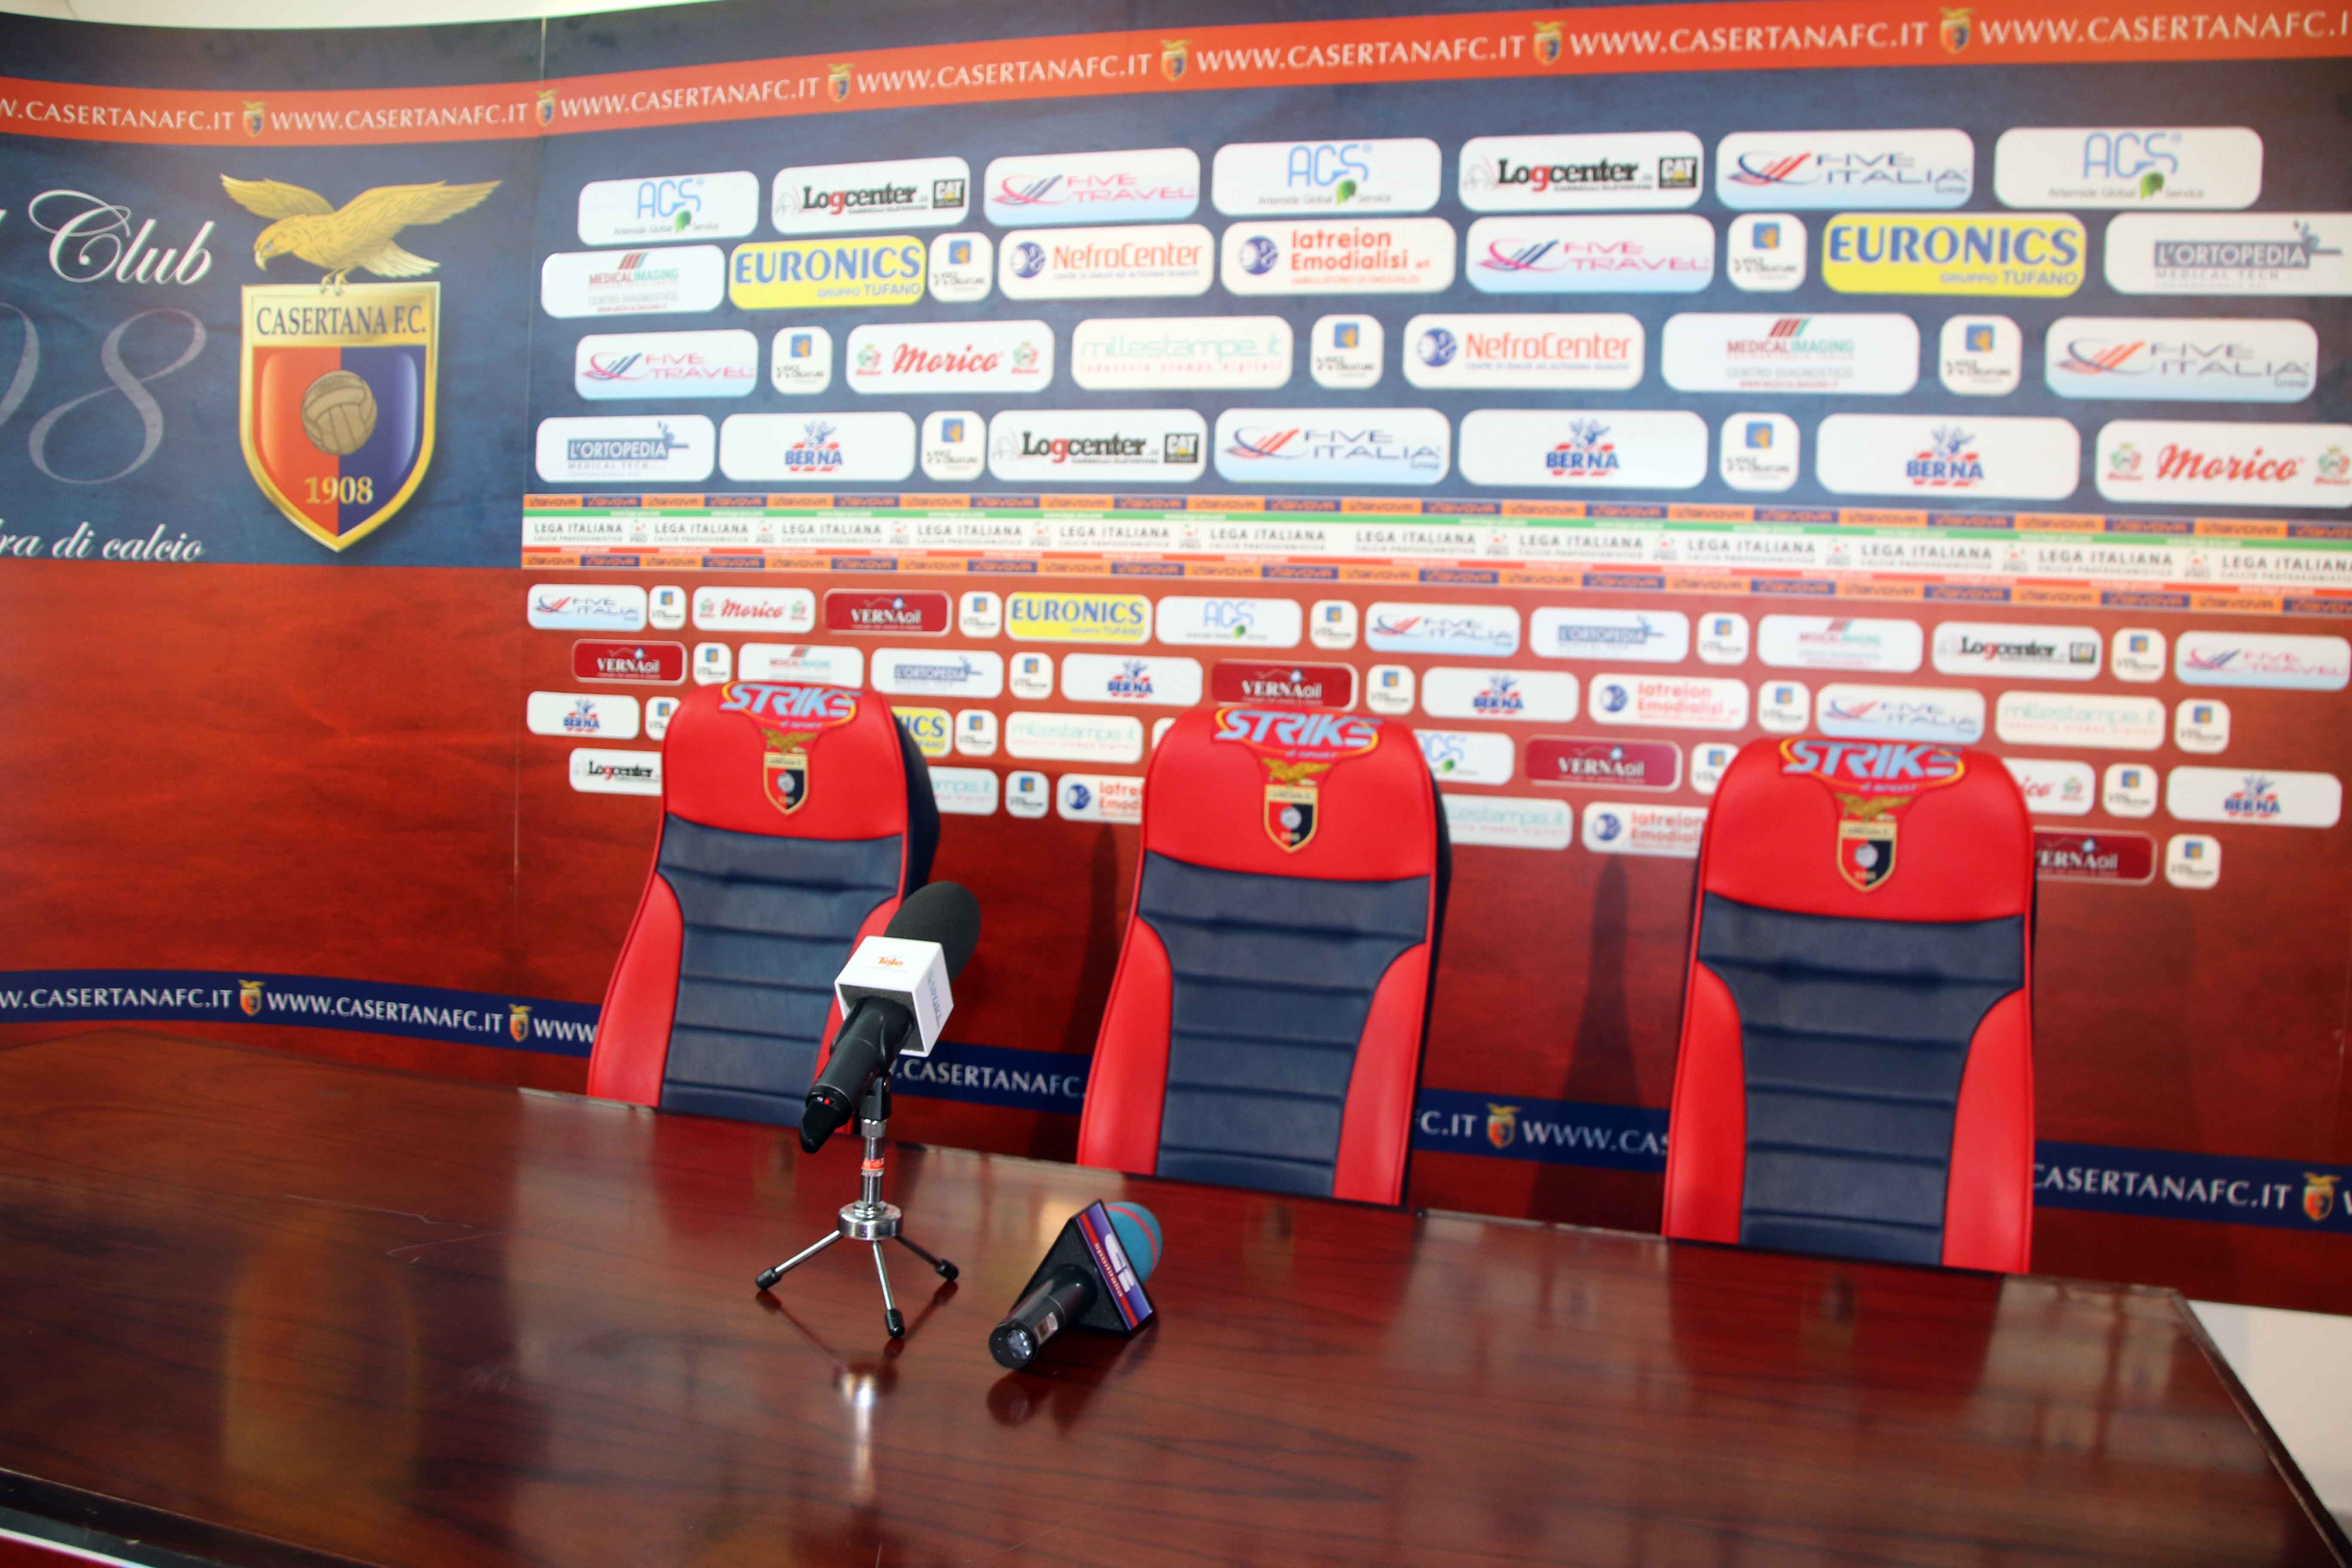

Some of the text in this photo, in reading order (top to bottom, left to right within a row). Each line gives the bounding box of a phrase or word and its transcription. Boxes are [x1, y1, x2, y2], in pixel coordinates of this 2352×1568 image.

[1570, 21, 1929, 57] WWW.CASERTANAFC.IT
[1196, 35, 1526, 73] WWW.CASERTANAFC.IT
[857, 53, 1152, 94] WWW.CASERTANAFC.IT
[560, 77, 820, 118] WWW.CASERTANAFC.IT
[270, 103, 528, 131] WWW.CASERTANAFC.IT
[1816, 152, 1915, 168] FIVE
[1066, 173, 1137, 187] FIVE
[1498, 156, 1639, 192] Logcenter
[1828, 169, 1967, 185] ITALIA
[802, 181, 917, 214] Logcenter
[1073, 185, 1193, 201] TRAVEL
[28, 189, 216, 285] Club
[1291, 227, 1391, 251] Iatreion
[1563, 240, 1642, 254] FIVE
[1829, 226, 2078, 266] EURONICS
[1052, 242, 1202, 271] NefroCenter
[1290, 249, 1409, 271] Emodialisi
[2159, 244, 2306, 266] L'ORTOPEDIA
[735, 244, 922, 284] EURONICS
[1570, 256, 1709, 272] TRAVEL
[2002, 270, 2078, 286] TUFANO
[864, 282, 921, 296] TUFANO
[257, 306, 426, 336] CASERTANA F.C.
[1466, 332, 1631, 360] NefroCenter
[2151, 343, 2254, 358] FIVE
[645, 353, 704, 366] FIVE
[892, 342, 1000, 373] Morico
[649, 366, 752, 379] TRAVEL
[2160, 360, 2310, 376] ITALIA
[1304, 430, 1393, 443] FIVE
[570, 441, 667, 458] L'ORTOPEDIA
[1022, 431, 1147, 465] Logcenter
[1314, 445, 1441, 459] ITALIA
[784, 449, 843, 466] BERNA
[1546, 451, 1620, 469] BERNA
[2156, 444, 2299, 481] Morico
[1906, 460, 1984, 479] BERNA
[304, 476, 373, 505] 1908
[534, 523, 623, 533] LEGA ITALIANA
[654, 523, 749, 534] LEGA ITALIANA
[781, 524, 882, 535] LEGA ITALIANA
[917, 524, 1023, 536] LEGA ITALIANA
[1060, 527, 1170, 538] LEGA ITALIANA
[1210, 529, 1326, 540] LEGA ITALIANA
[0, 518, 206, 564] ra di calcio
[1356, 530, 1476, 544] LEGA ITALIANA
[1519, 535, 1644, 549] LEGA ITALIANA
[1687, 539, 1815, 554] LEGA ITALIANA
[1861, 544, 1992, 559] LEGA ITALIANA
[2039, 551, 2174, 565] LEGA ITALIANA
[2221, 555, 2352, 572] LEGA ITALIAN
[721, 598, 785, 619] Morico
[1012, 599, 1144, 625] EURONICS
[1961, 636, 2057, 660] Logcenter
[563, 716, 600, 729] BERNA
[588, 760, 654, 780] Logcenter
[2223, 799, 2282, 814] BERNA
[266, 992, 504, 1033] WWW.CASERTANAFC.IT
